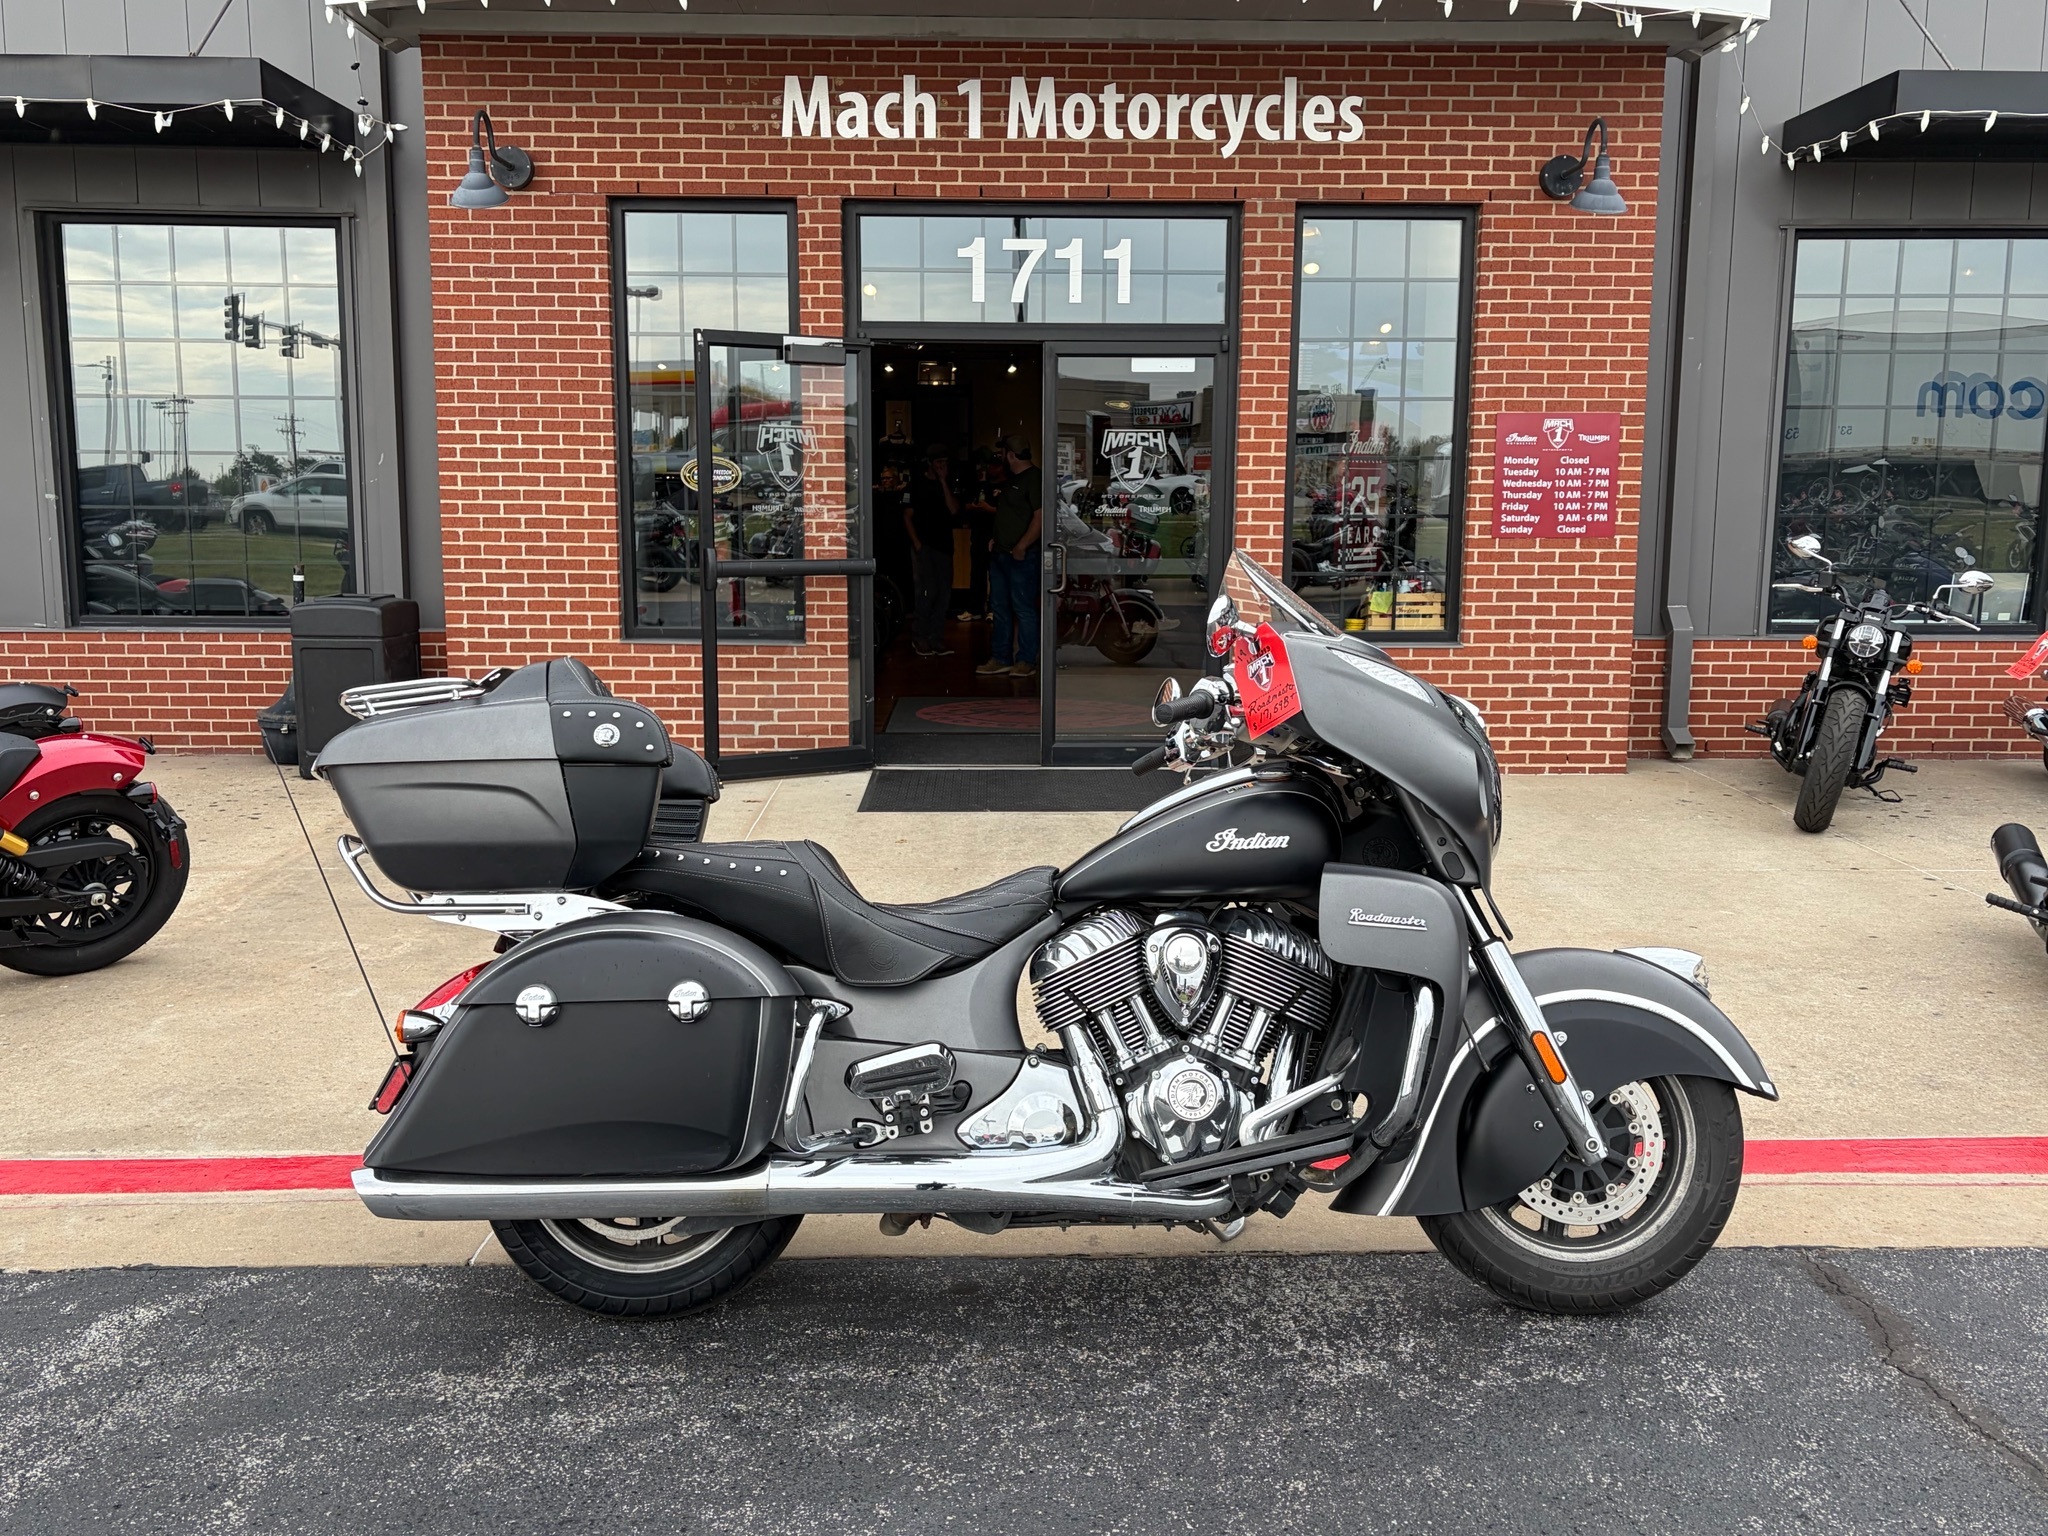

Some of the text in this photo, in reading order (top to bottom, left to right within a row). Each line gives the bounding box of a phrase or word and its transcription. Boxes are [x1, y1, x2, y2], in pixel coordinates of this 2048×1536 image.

[781, 74, 1365, 159] Mach 1 Motorcycles
[957, 236, 1132, 305] 1711
[1545, 420, 1572, 430] MACH
[1505, 432, 1538, 442] Indian
[1553, 426, 1562, 442] 1
[1105, 432, 1164, 453] MACH
[1124, 446, 1145, 479] 1
[1504, 456, 1589, 466] Monday Closed
[1503, 468, 1539, 477] Tuesday
[1555, 468, 1564, 476] 10
[1567, 468, 1582, 476] AM
[1589, 468, 1594, 476] 7
[1596, 468, 1609, 476] PM
[1503, 480, 1552, 489] Wednesday
[1502, 491, 1542, 500] Thursday
[1095, 504, 1172, 514] Indian TRIUMPH
[1502, 503, 1529, 511] Friday
[1501, 514, 1540, 523] Saturday
[1558, 514, 1563, 522] 9
[1566, 514, 1580, 522] AM
[1587, 514, 1592, 522] 6
[1594, 514, 1607, 522] PM
[1500, 525, 1586, 535] Sunday Closed
[1248, 653, 1274, 678] MACH
[1205, 828, 1290, 852] Indian
[1349, 908, 1427, 927] Roadmaster
